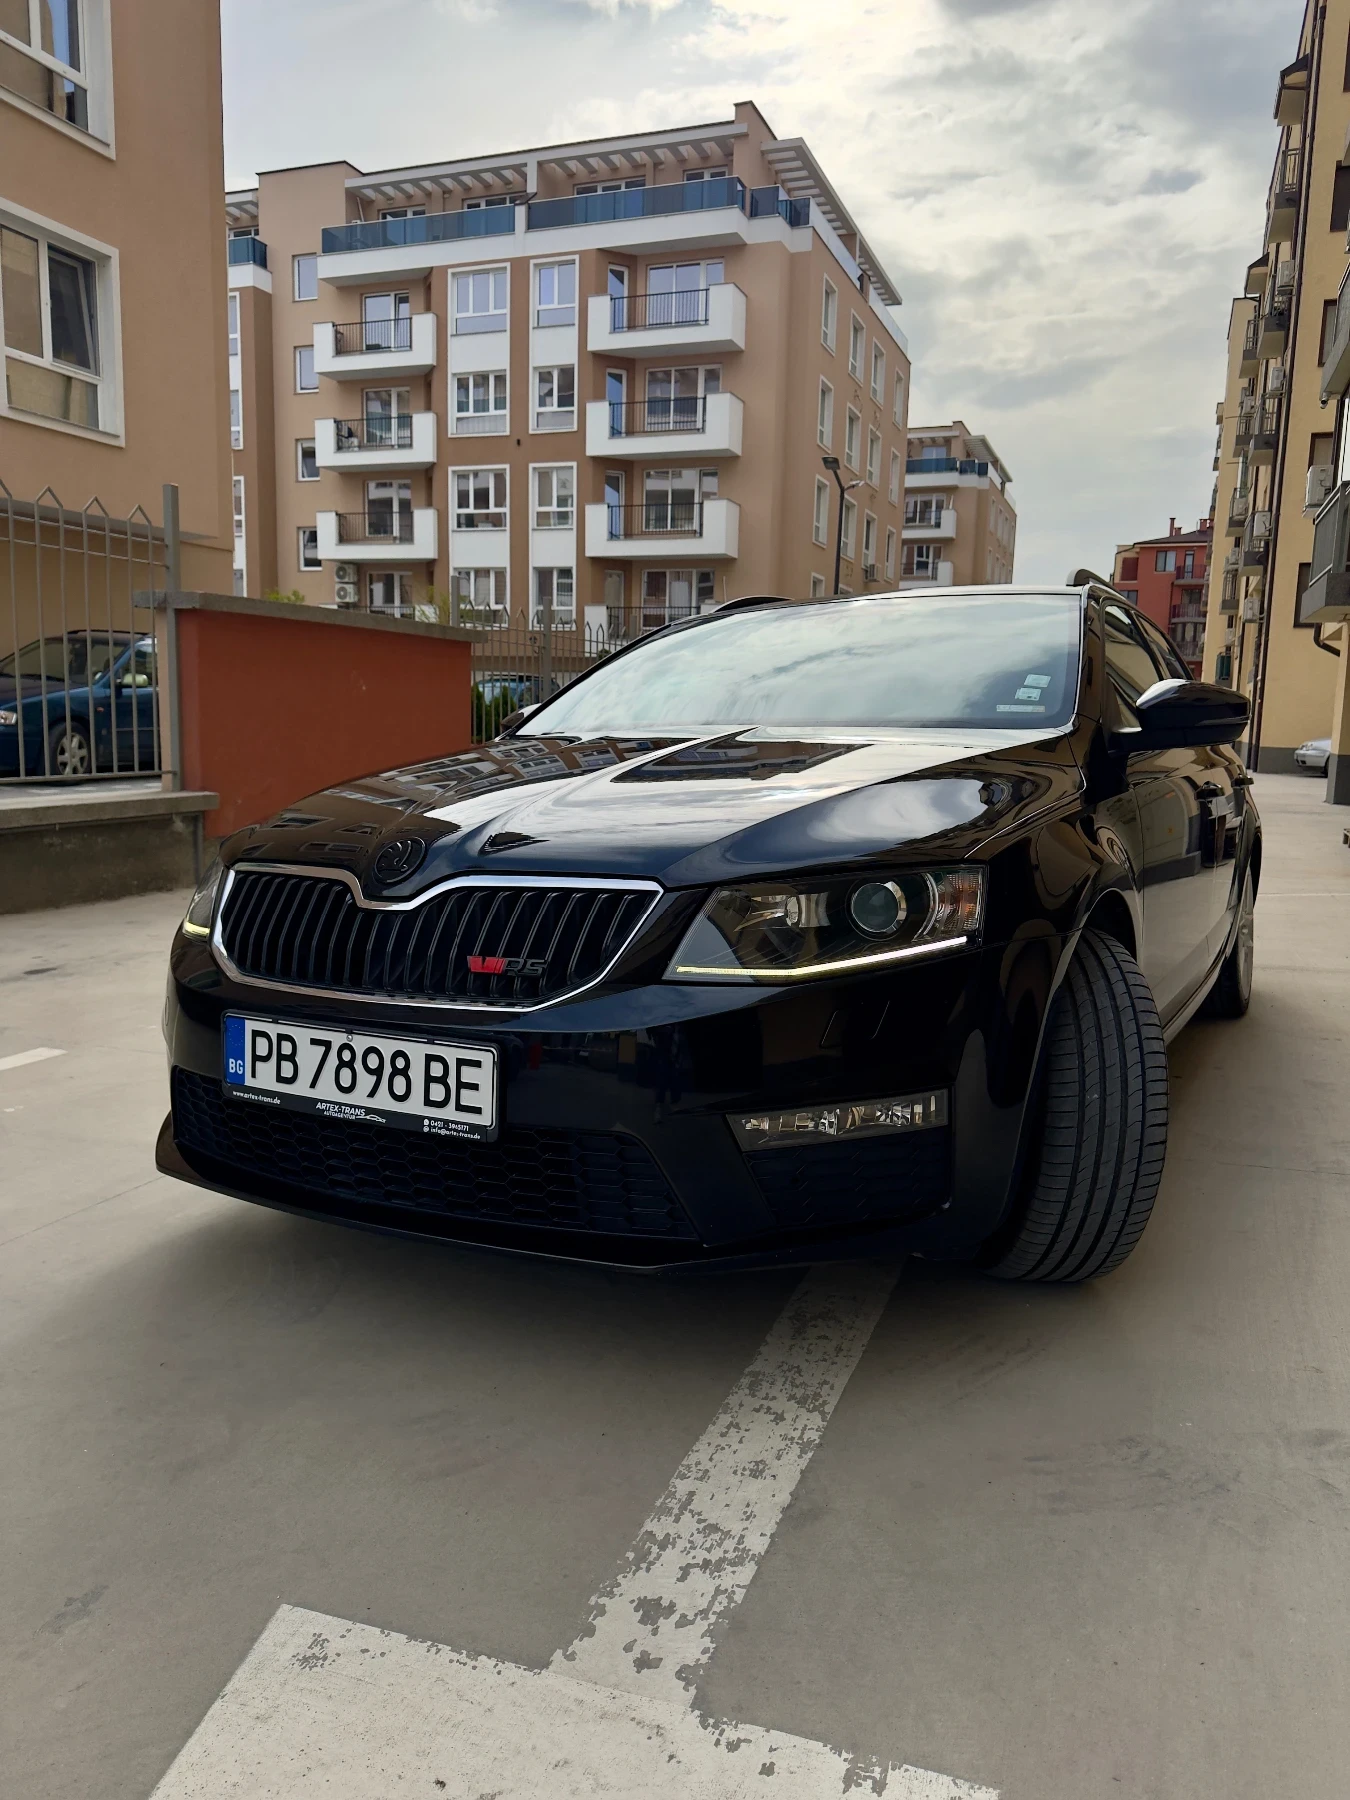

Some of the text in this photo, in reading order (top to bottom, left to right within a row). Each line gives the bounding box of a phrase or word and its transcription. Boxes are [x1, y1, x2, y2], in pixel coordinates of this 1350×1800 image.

[228, 1058, 244, 1075] BG
[250, 1028, 483, 1115] PB 7898 BE
[315, 1101, 366, 1117] ARTEX-TRANS
[323, 1110, 356, 1120] AUTOAGENTUR
